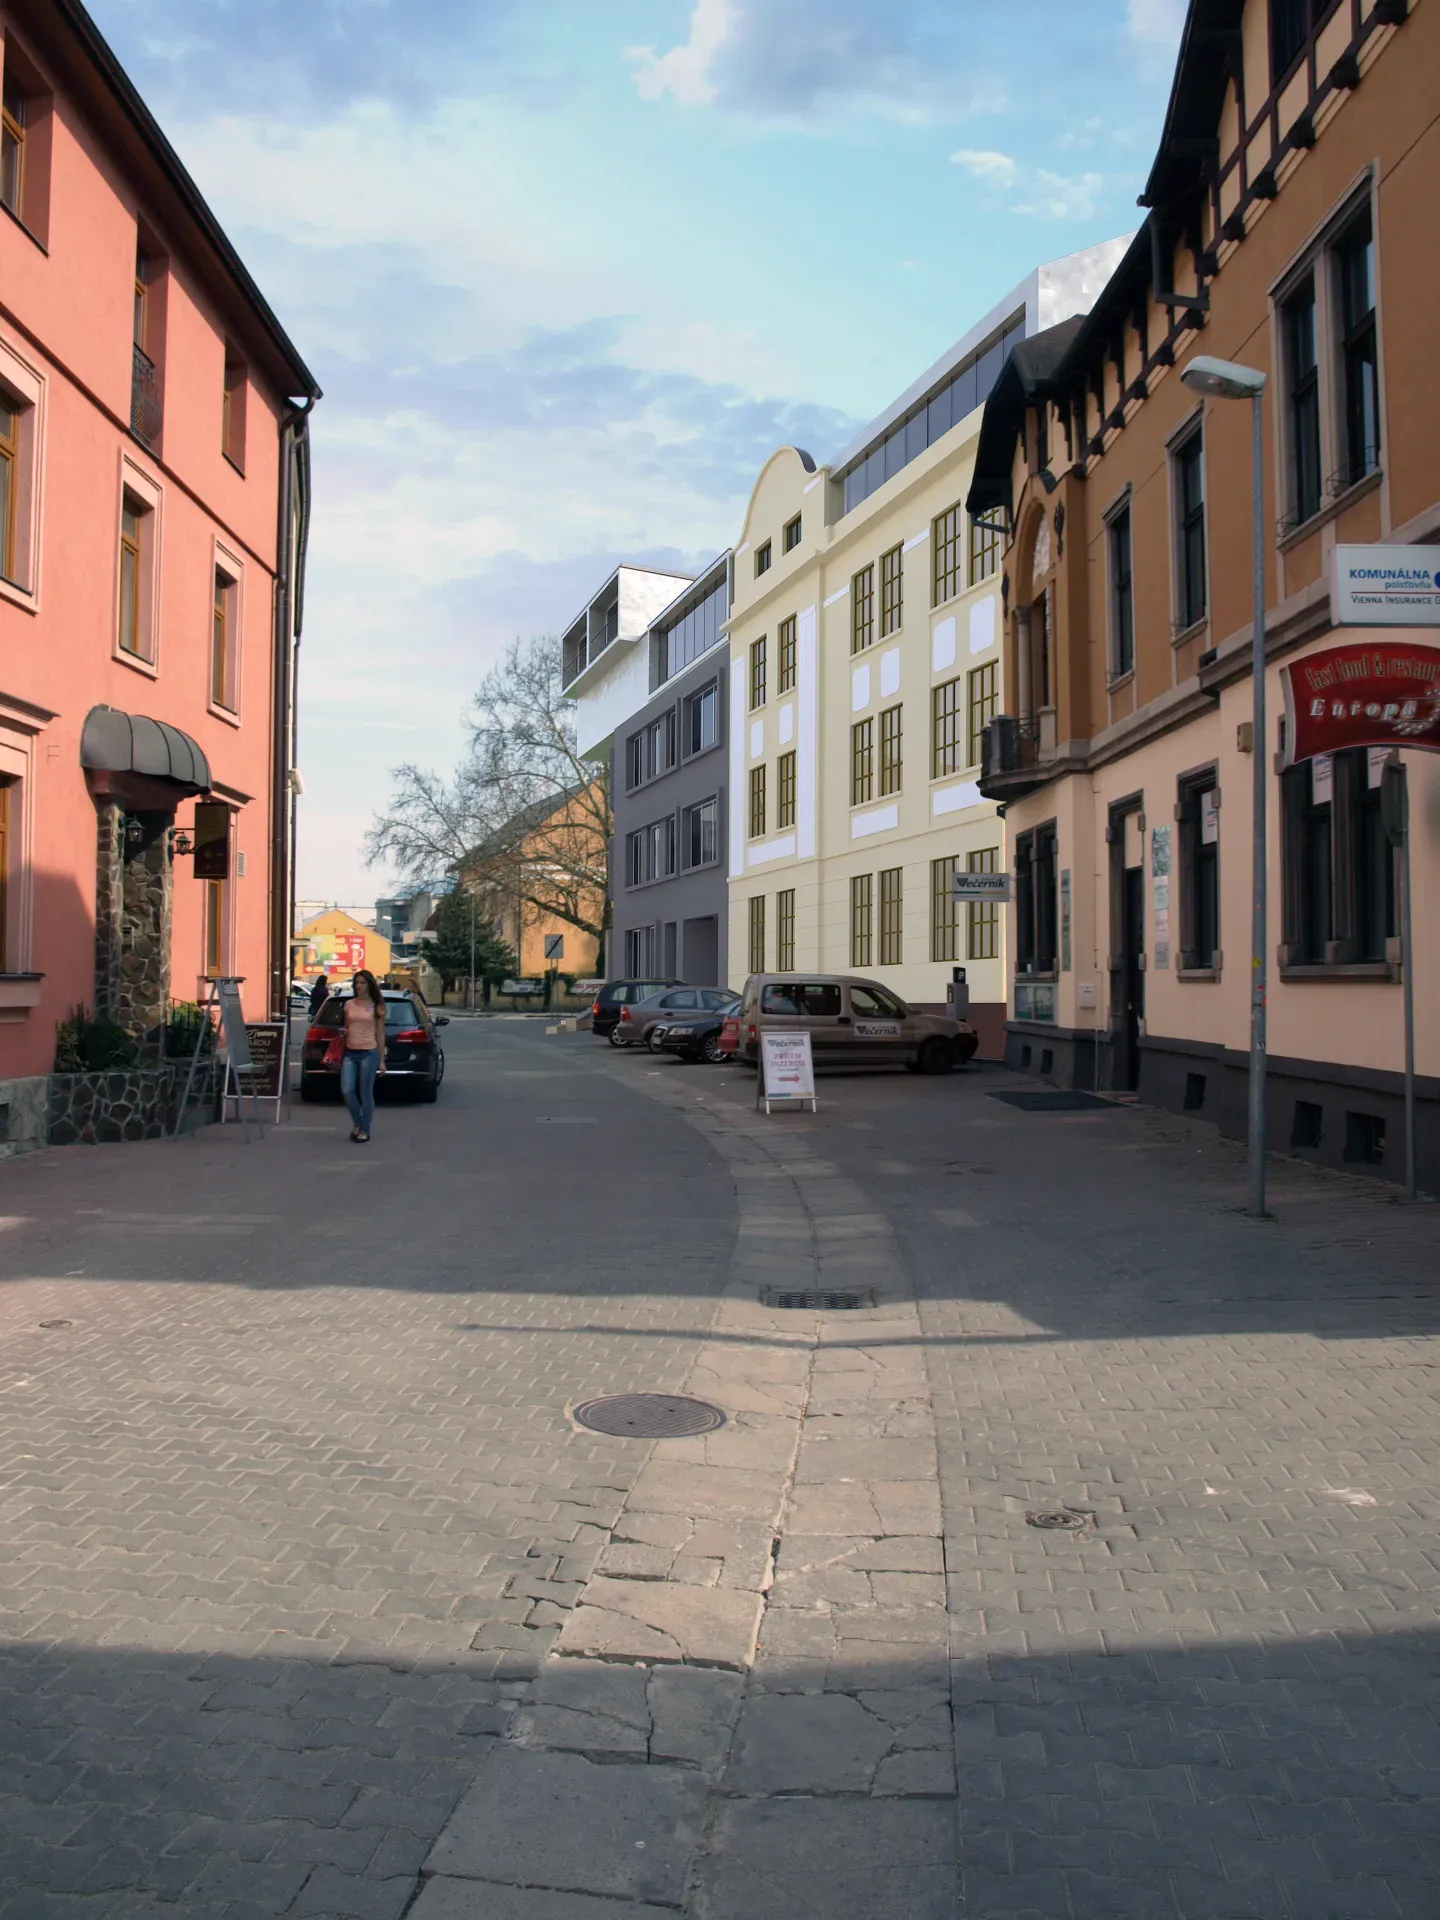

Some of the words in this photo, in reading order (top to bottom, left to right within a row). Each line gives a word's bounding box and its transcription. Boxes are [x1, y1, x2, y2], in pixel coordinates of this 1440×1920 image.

[1349, 568, 1431, 580] KOMUNÁLNA
[1351, 595, 1383, 604] VIENNA
[1385, 595, 1432, 605] INSURANCE
[1335, 653, 1371, 682] food
[1309, 699, 1418, 721] Europa
